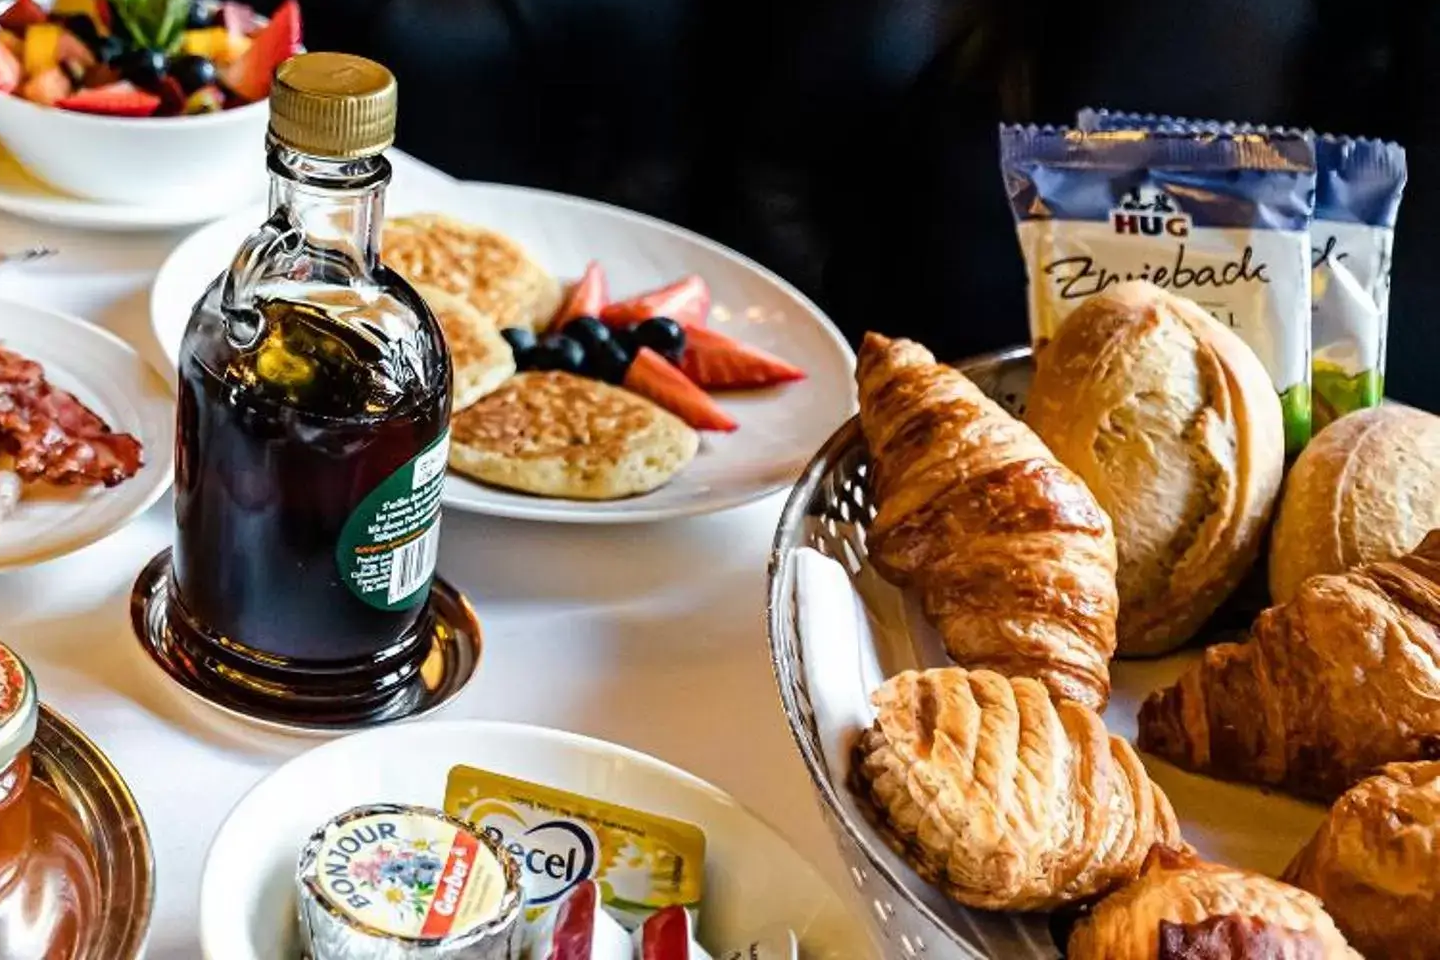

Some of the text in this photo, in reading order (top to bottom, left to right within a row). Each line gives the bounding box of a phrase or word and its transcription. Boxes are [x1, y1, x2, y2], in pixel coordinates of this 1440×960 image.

[1115, 213, 1188, 237] HUG
[324, 821, 399, 910] BONJOUR
[433, 857, 470, 917] Gerber
